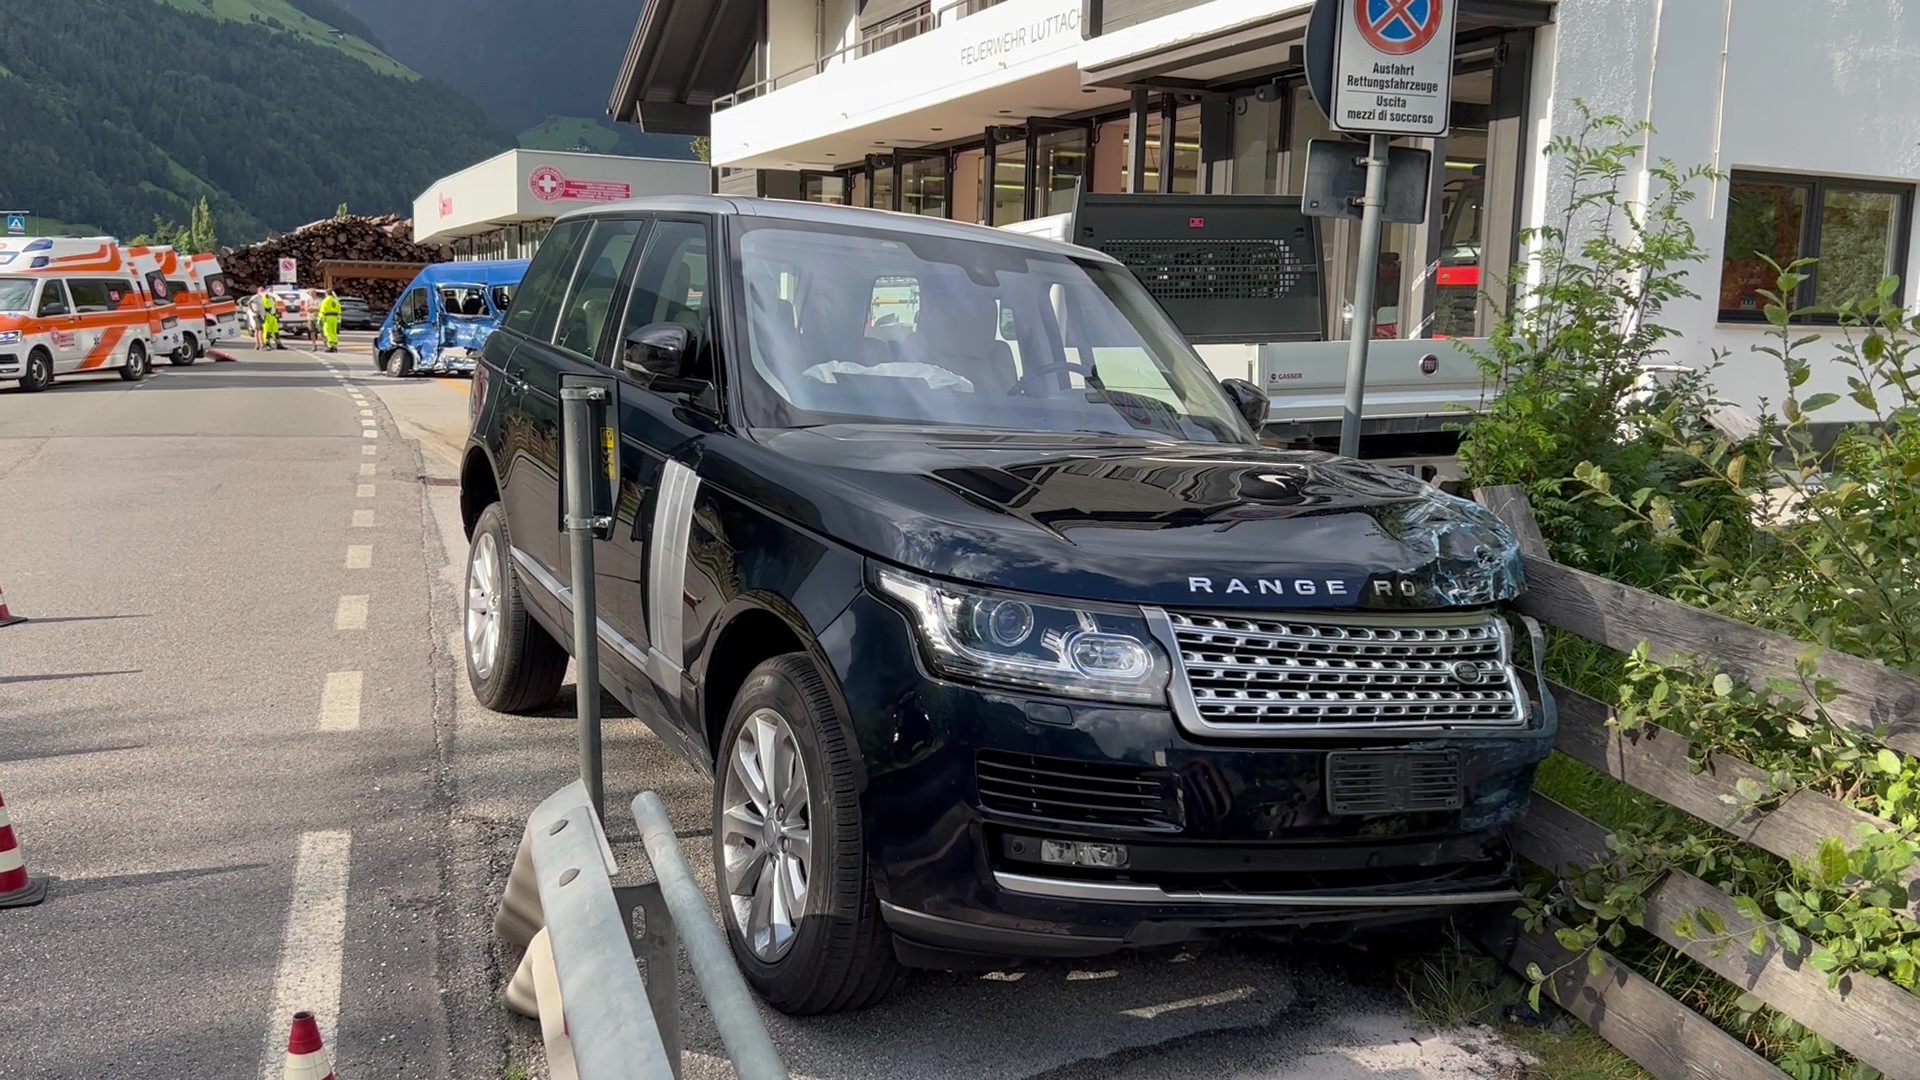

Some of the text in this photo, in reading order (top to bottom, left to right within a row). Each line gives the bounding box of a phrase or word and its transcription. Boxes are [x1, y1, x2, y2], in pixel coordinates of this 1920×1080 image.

[960, 26, 1027, 66] FEUERWEHR
[1372, 62, 1415, 76] Ausfahrt
[1346, 74, 1438, 93] Rettungsfahrzeuge
[1376, 95, 1407, 108] Uscita
[1347, 109, 1434, 124] mezzi di soccorso
[1278, 372, 1303, 380] GASSER
[1188, 576, 1348, 596] RANGE
